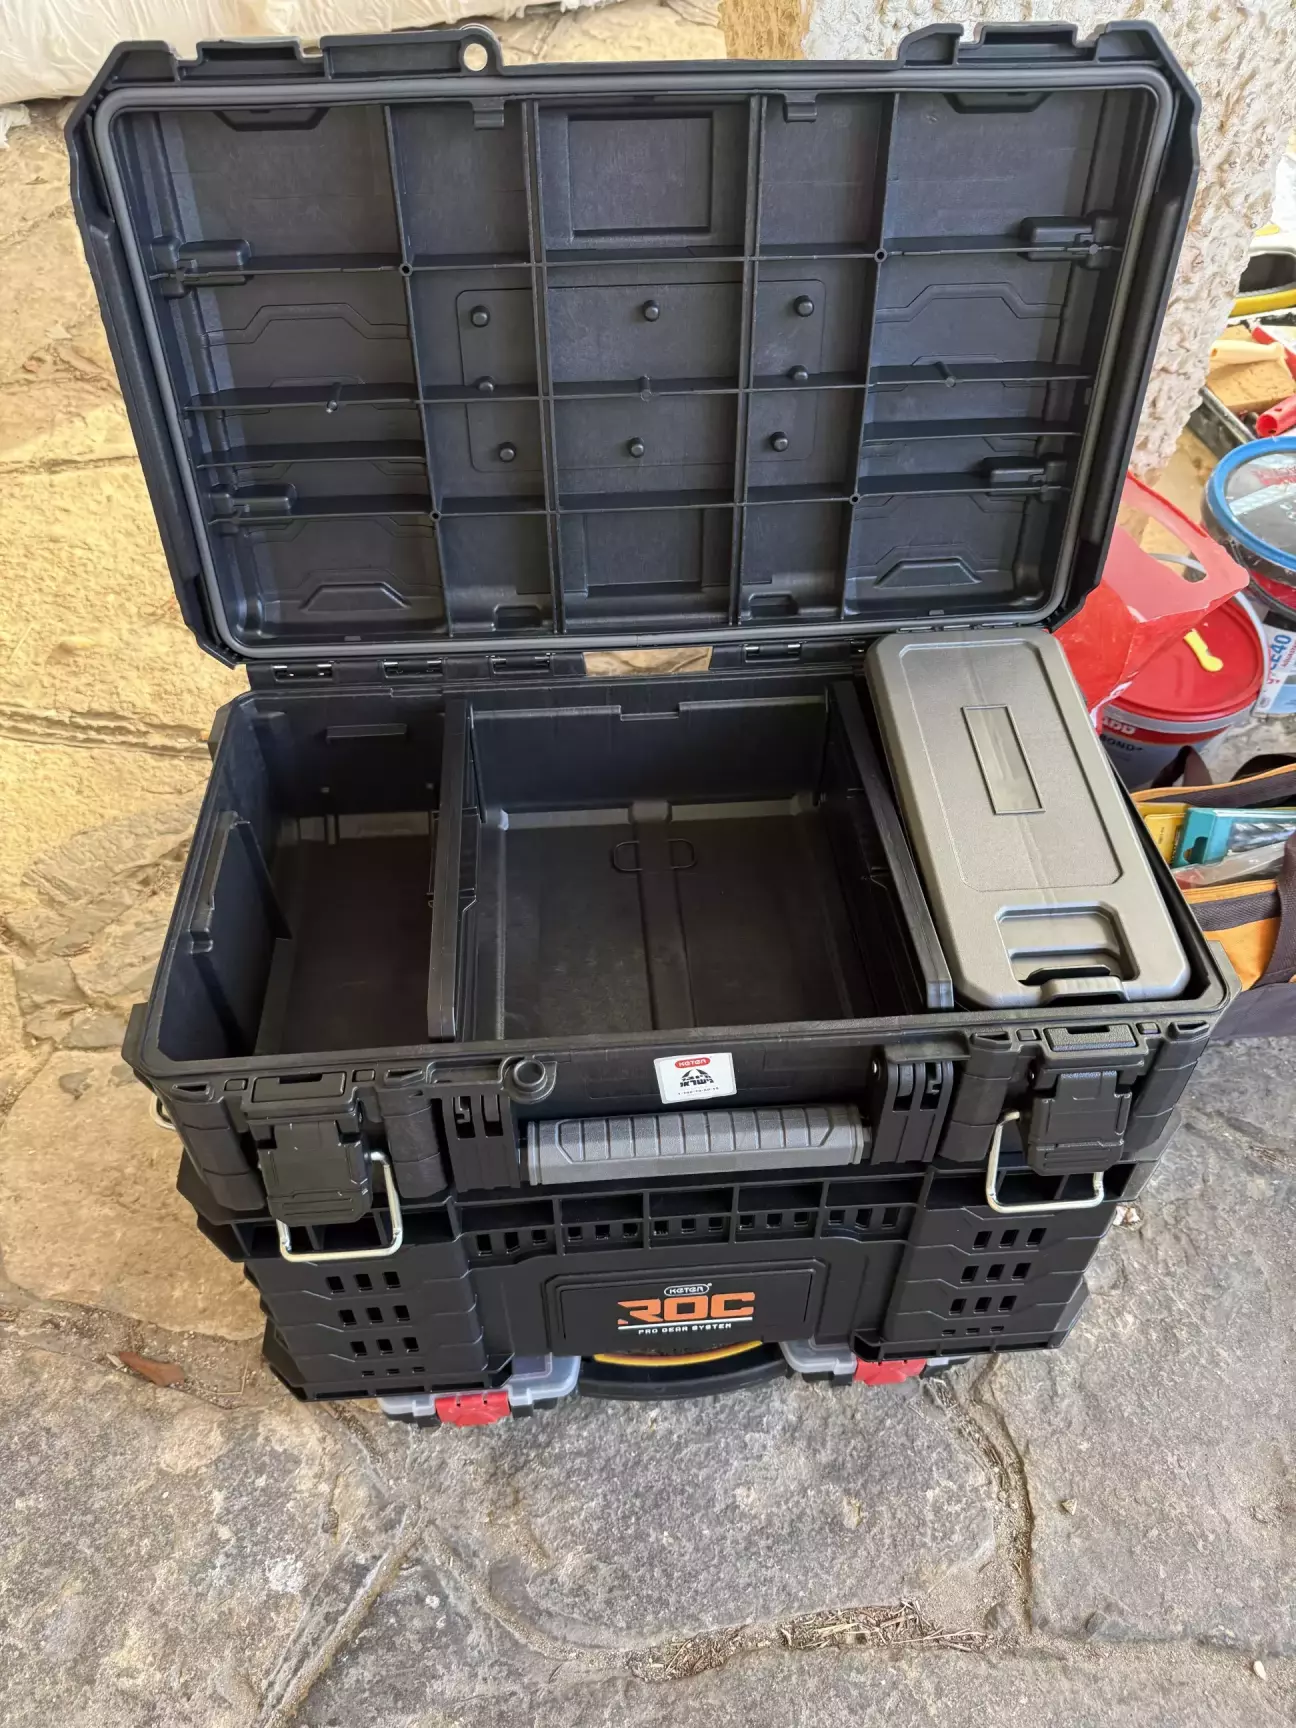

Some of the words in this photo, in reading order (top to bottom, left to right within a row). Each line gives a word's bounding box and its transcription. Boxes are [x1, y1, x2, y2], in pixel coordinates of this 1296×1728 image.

[669, 1286, 704, 1295] KETER
[617, 1292, 756, 1325] ROC
[692, 1323, 732, 1331] SYSTEM
